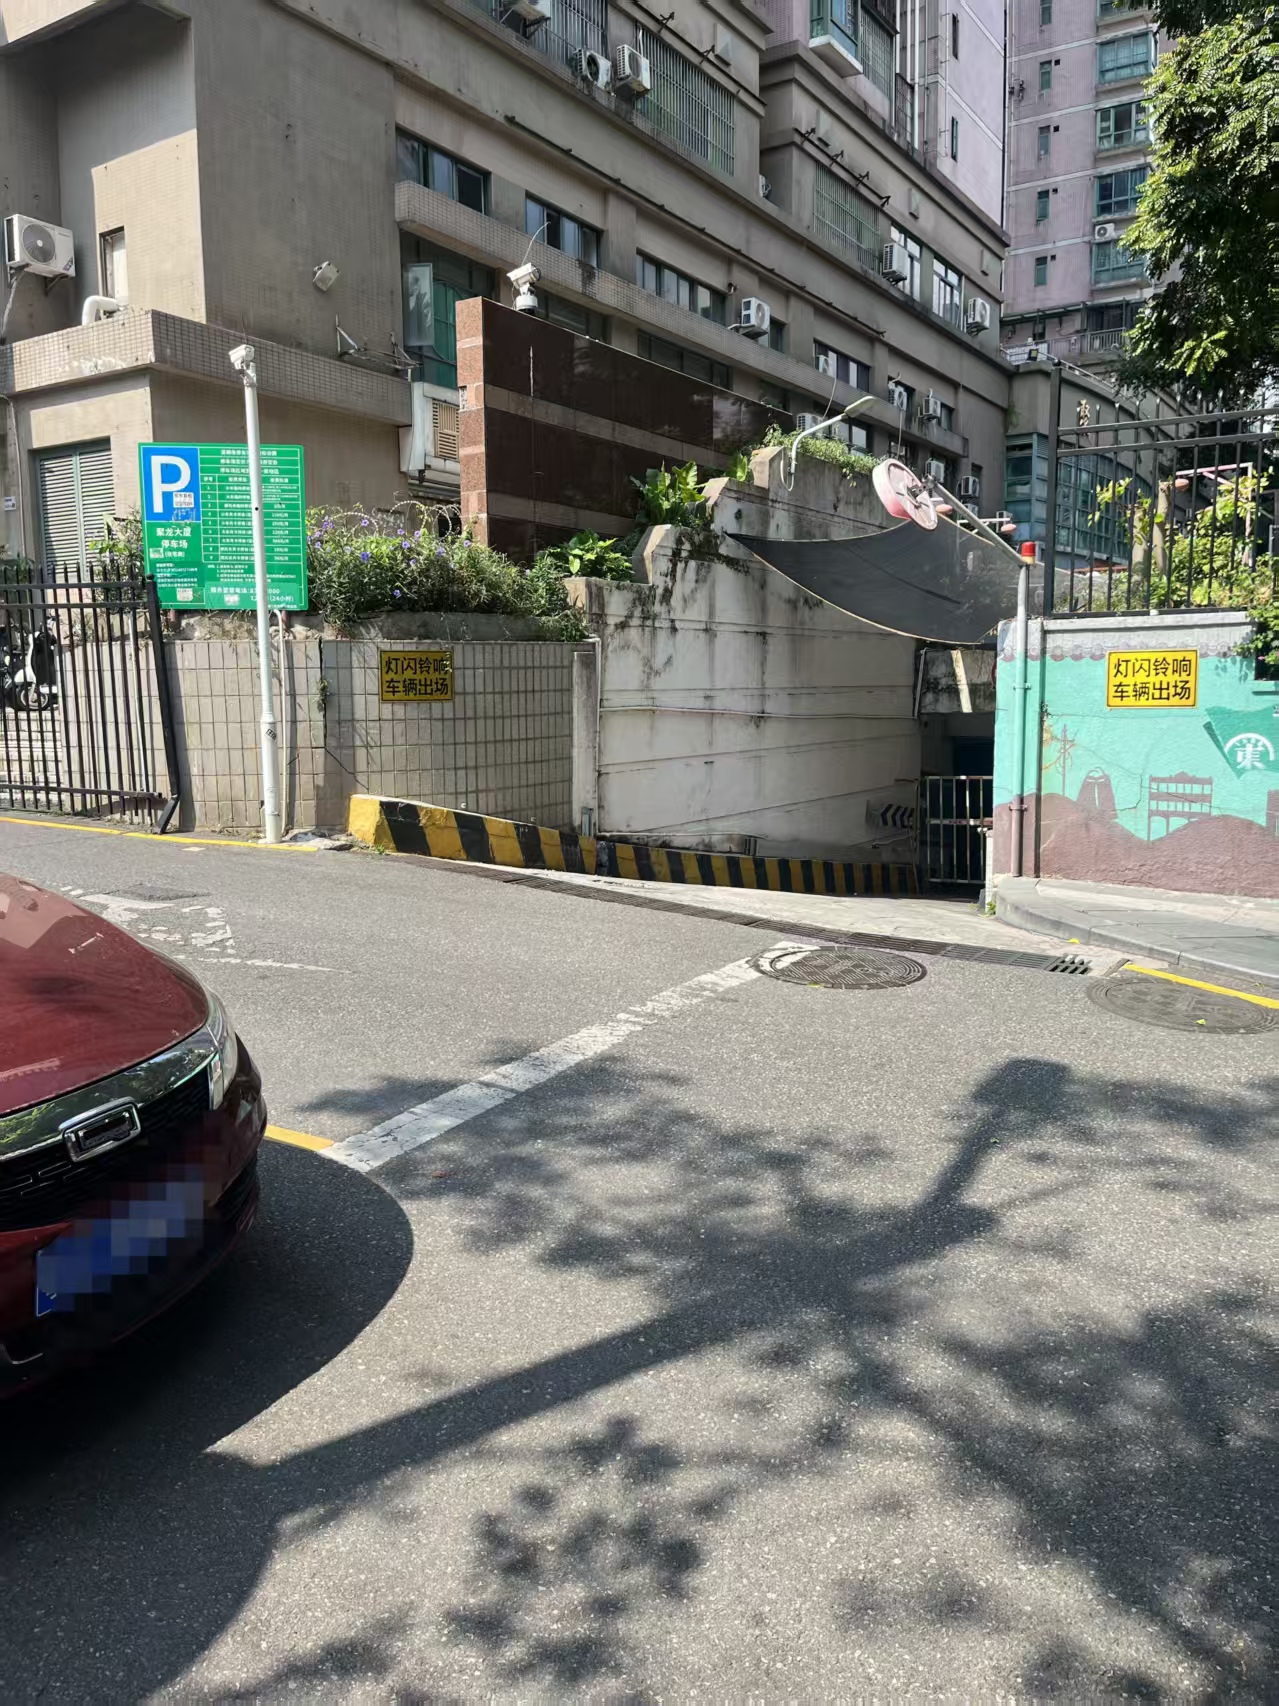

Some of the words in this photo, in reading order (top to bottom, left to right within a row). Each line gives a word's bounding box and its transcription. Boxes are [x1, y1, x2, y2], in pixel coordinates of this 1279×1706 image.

[151, 455, 191, 513] P
[161, 539, 188, 549] 停车场
[385, 656, 449, 675] 灯闪铃响
[1113, 656, 1192, 678] 灯闪铃响
[385, 677, 449, 697] 车辆出场
[1112, 680, 1191, 702] 车辆出场
